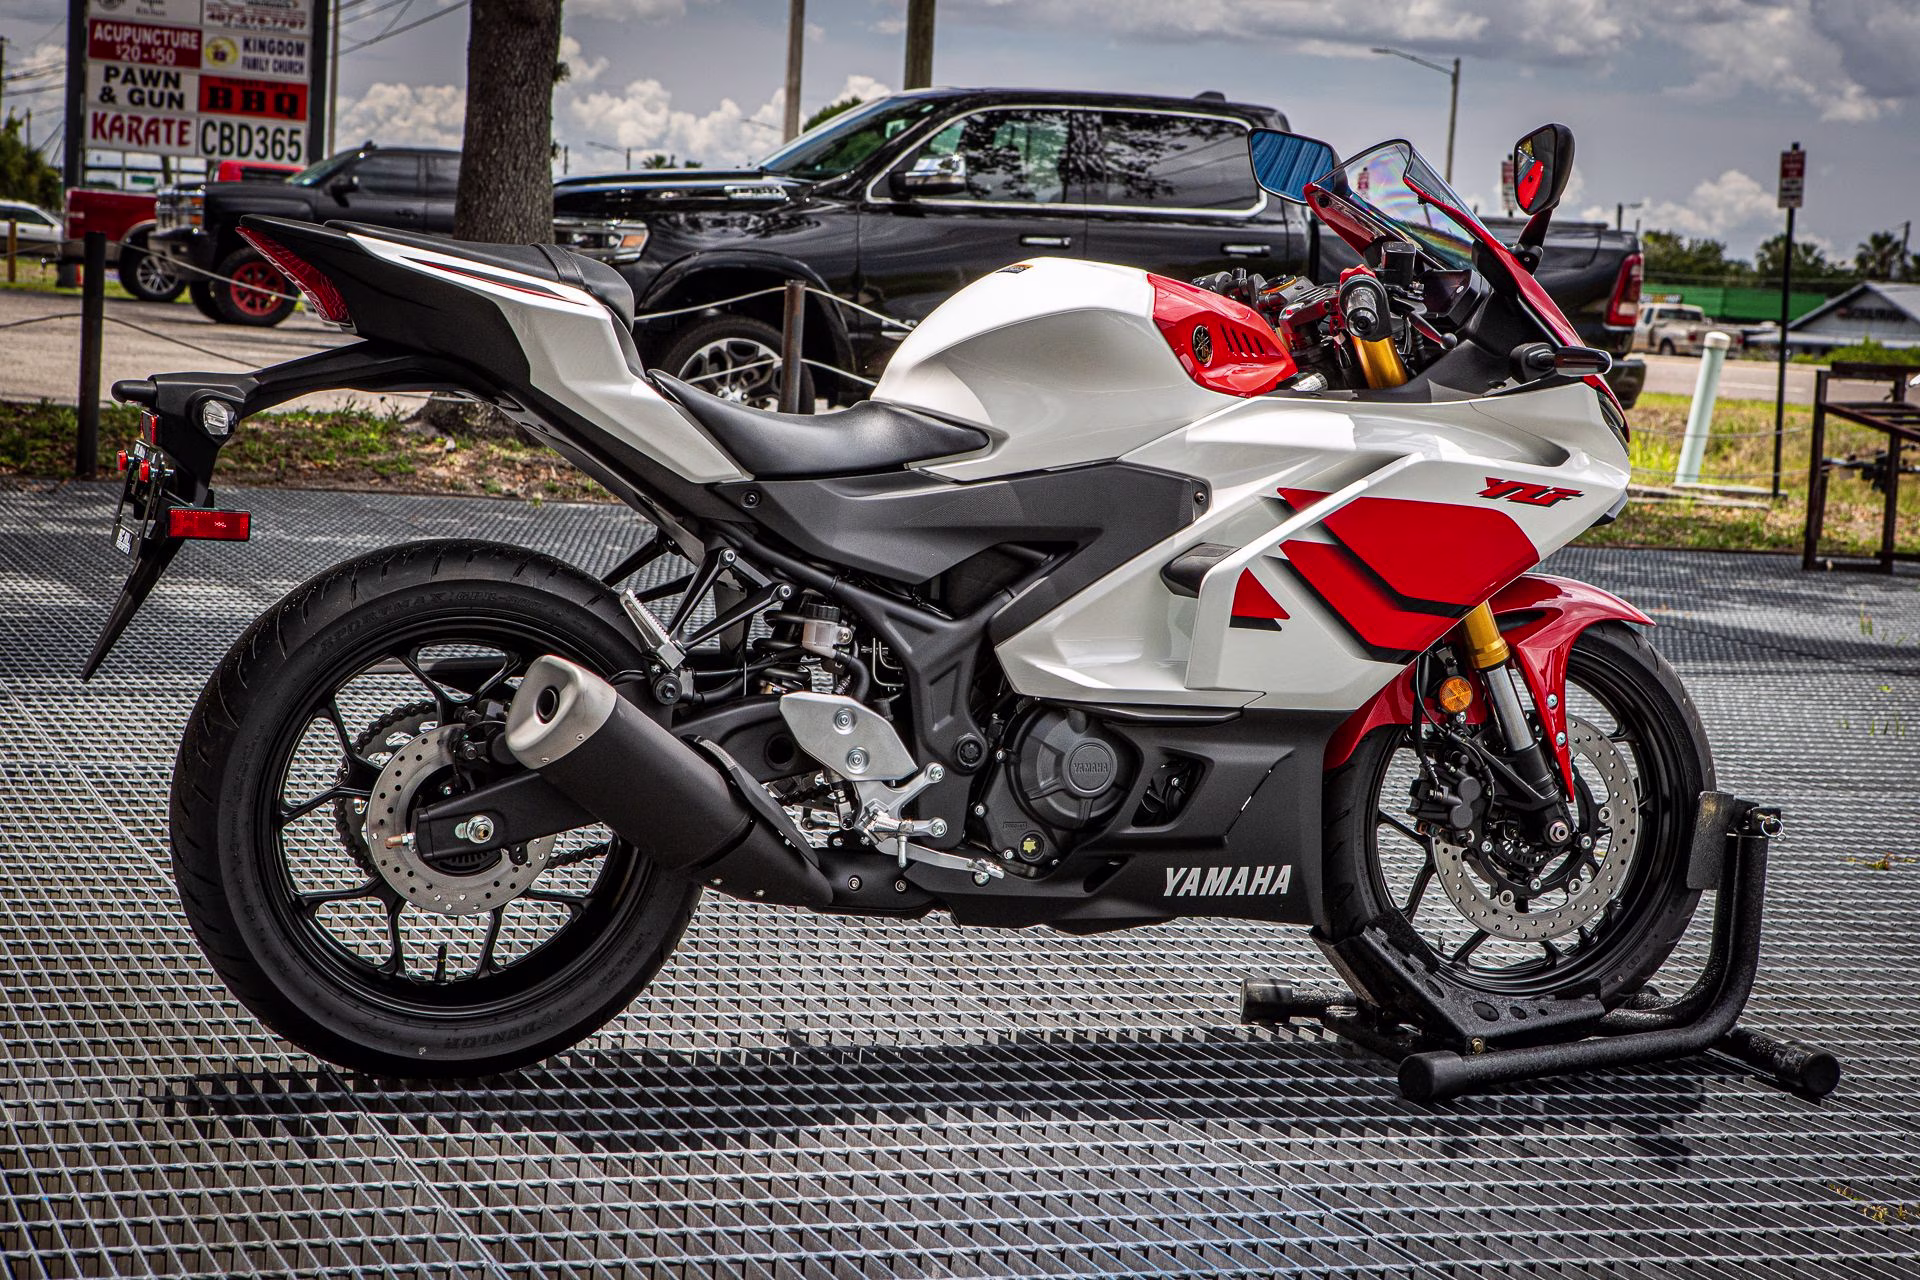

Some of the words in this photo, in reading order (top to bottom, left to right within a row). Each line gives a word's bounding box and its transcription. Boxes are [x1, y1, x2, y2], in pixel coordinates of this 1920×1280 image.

[94, 22, 198, 50] ACUPUNCTURE
[243, 36, 305, 57] KINGDOM
[104, 65, 180, 89] PAWN
[242, 55, 270, 72] FAMILY
[271, 58, 304, 74] CHURCH
[99, 85, 117, 105] &
[127, 88, 184, 110] GUN
[208, 86, 298, 120] BBQ
[92, 111, 191, 147] KARATE
[201, 120, 302, 162] CBD365
[1073, 762, 1110, 774] YAMAHA
[1163, 864, 1292, 897] YAMAHA
